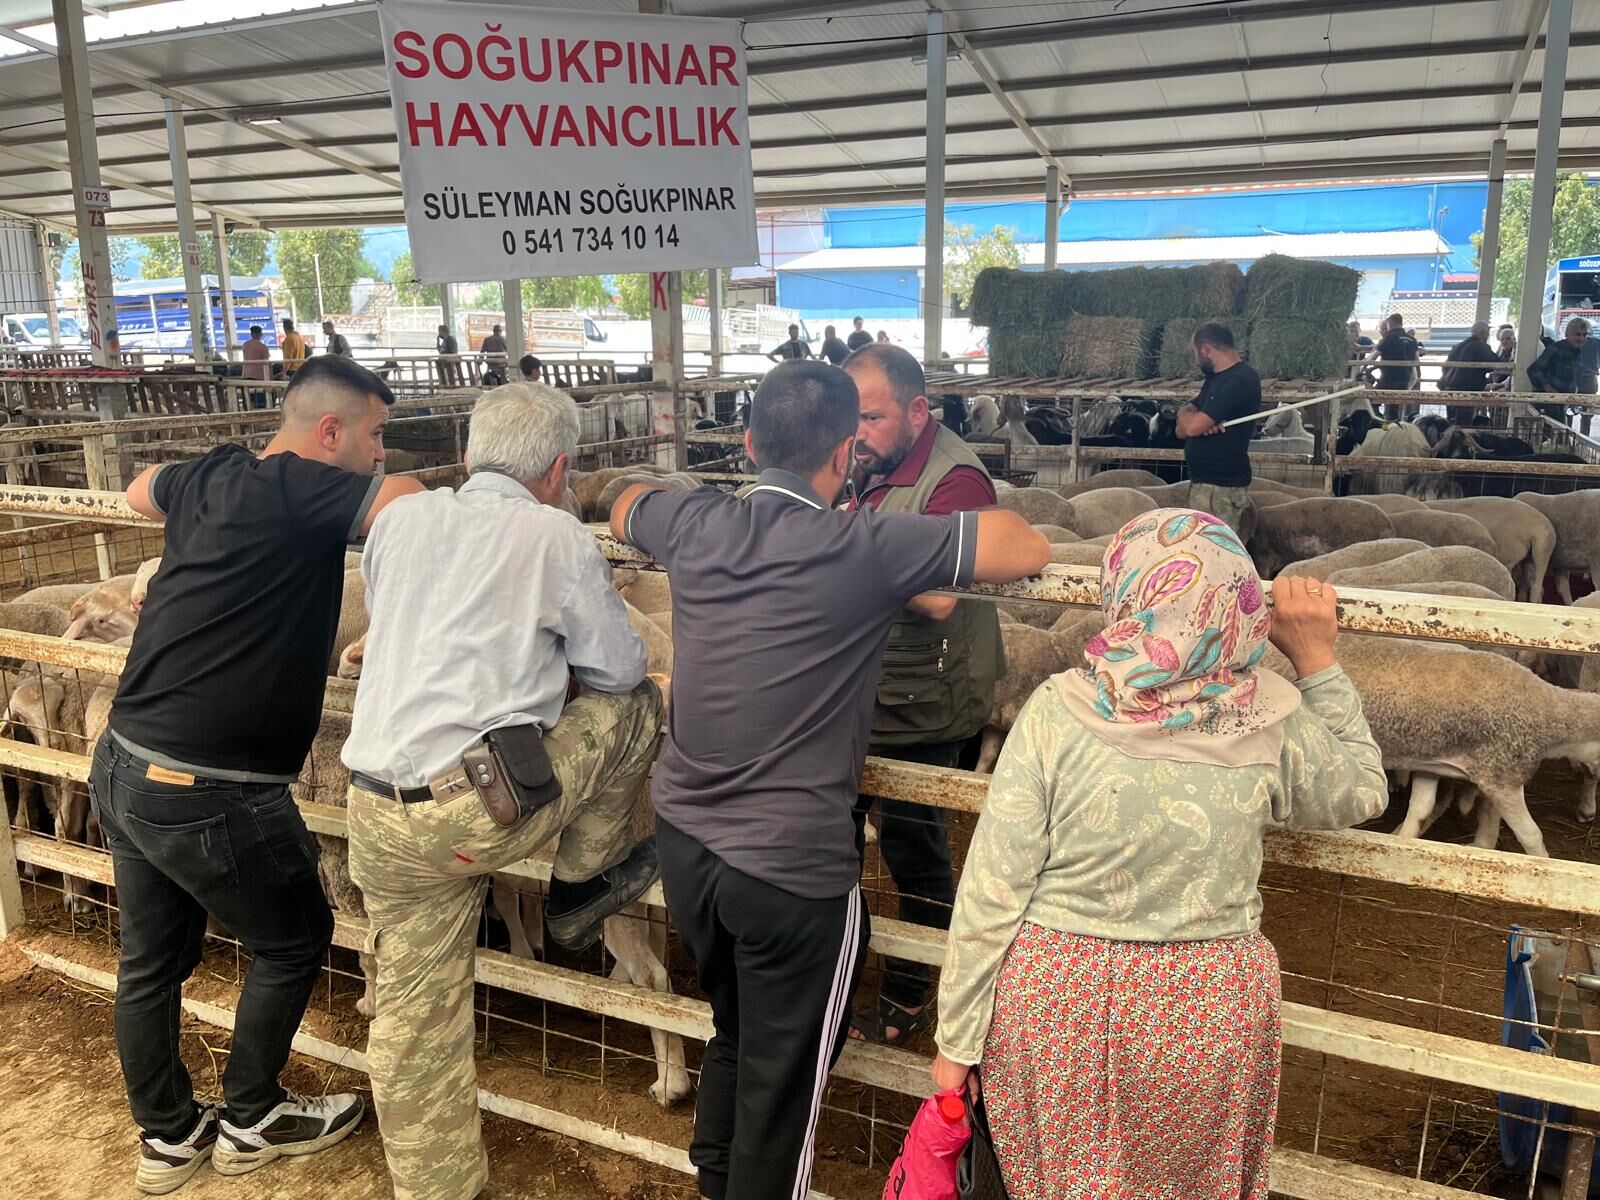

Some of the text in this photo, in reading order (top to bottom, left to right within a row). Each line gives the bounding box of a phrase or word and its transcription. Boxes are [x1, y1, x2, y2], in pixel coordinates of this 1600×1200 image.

[393, 23, 739, 86] SOĞUKPINAR
[406, 102, 740, 147] HAYVANCILIK
[85, 191, 109, 202] 073
[424, 183, 736, 220] SÜLEYMAN SOĞUKPINAR
[88, 210, 105, 227] 73
[502, 224, 680, 255] 0 541 734 10 14
